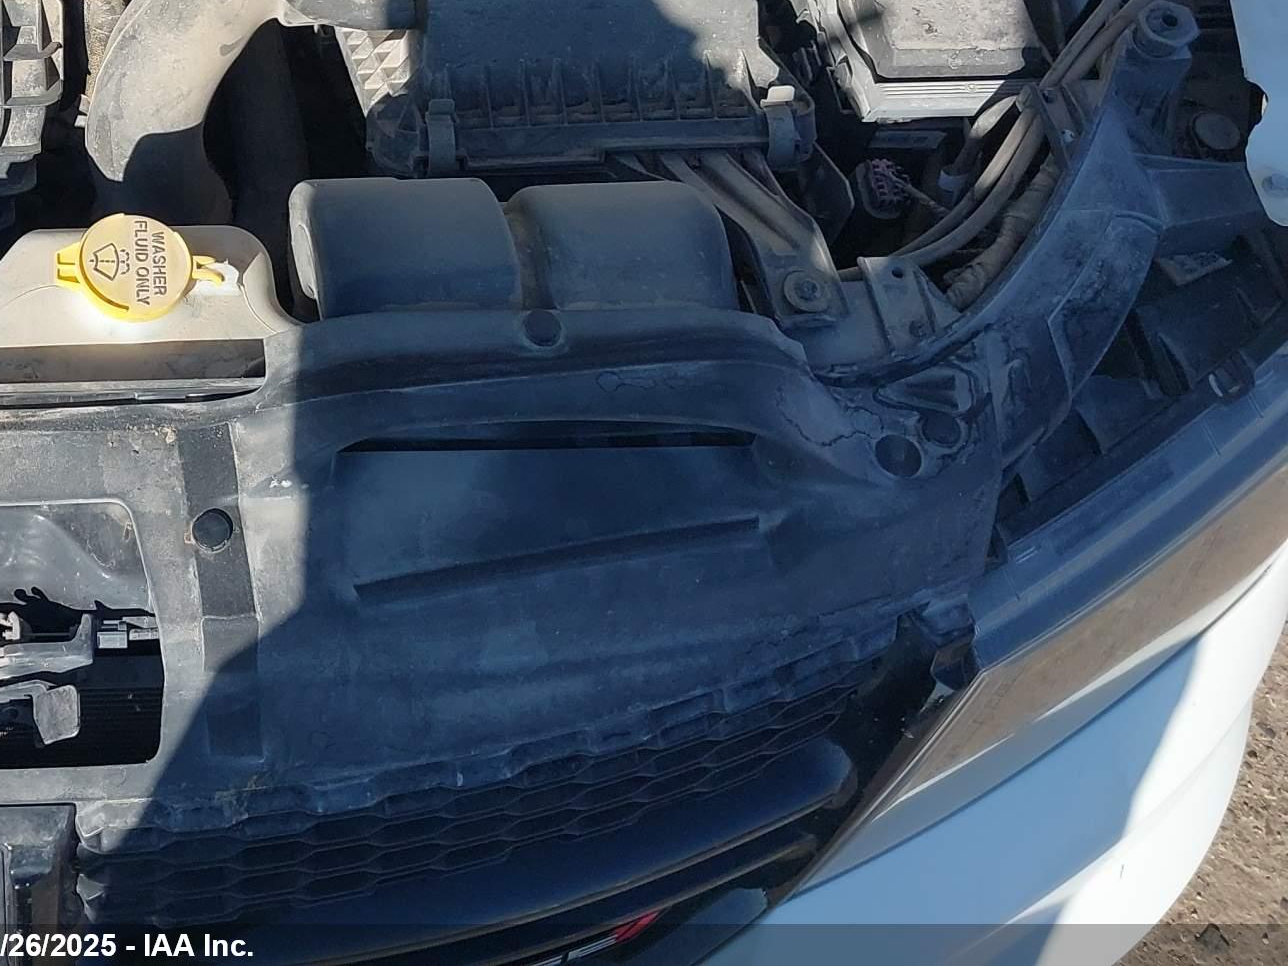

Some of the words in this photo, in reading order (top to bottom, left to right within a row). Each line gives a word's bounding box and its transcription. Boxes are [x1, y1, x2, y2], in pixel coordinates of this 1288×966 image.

[134, 220, 149, 263] FLUID
[151, 231, 168, 296] WASHER
[135, 267, 151, 306] ONLY
